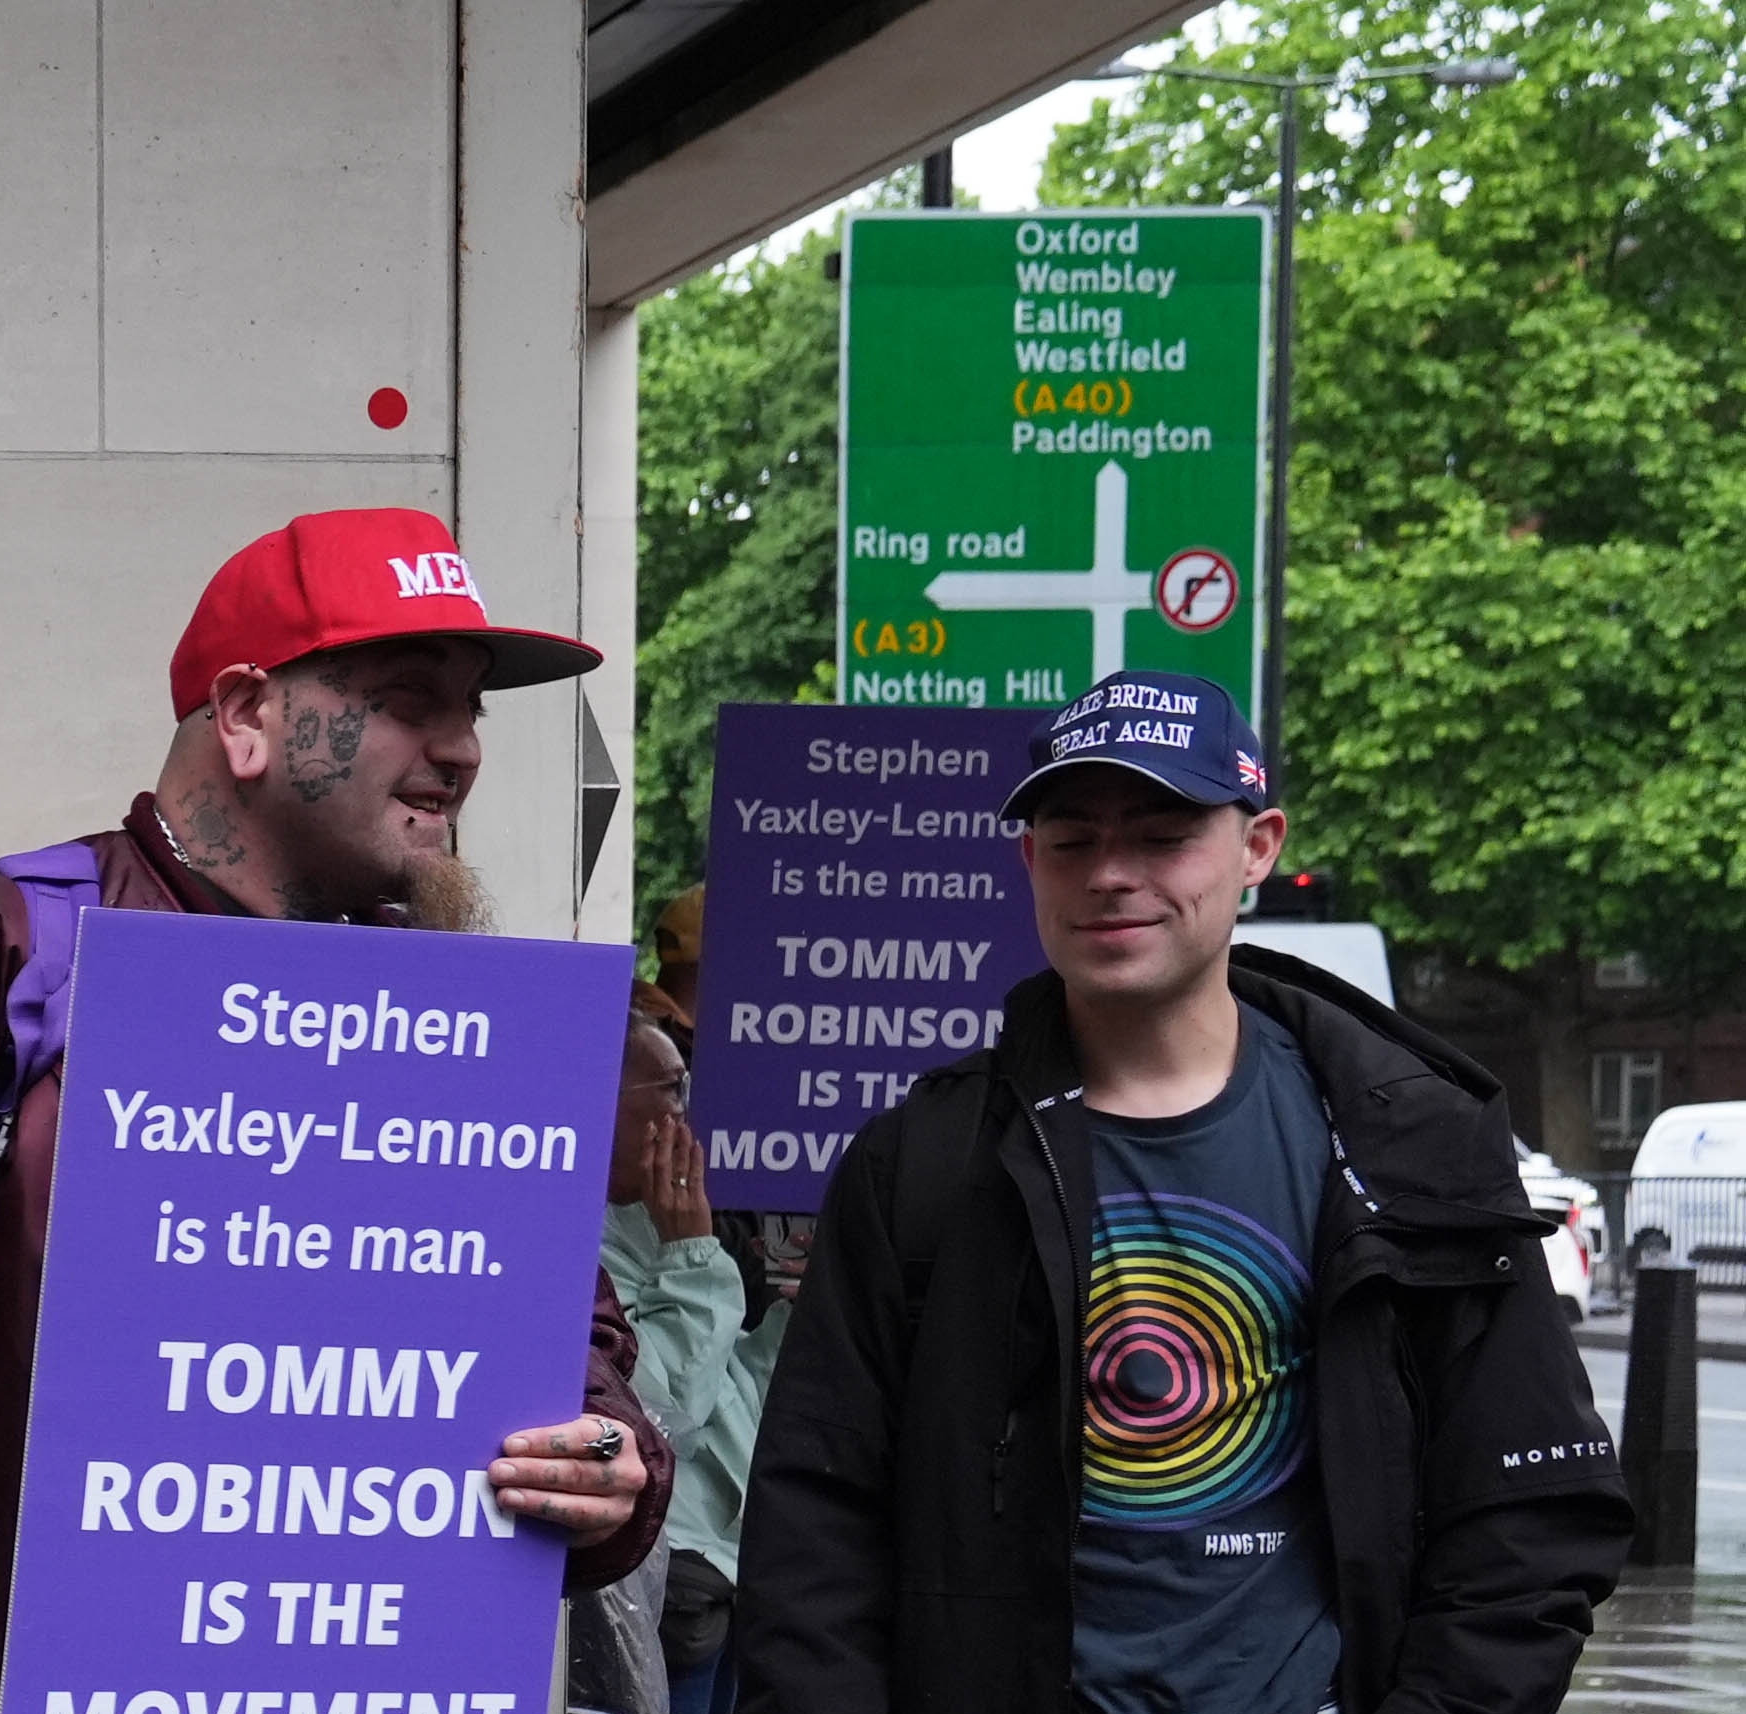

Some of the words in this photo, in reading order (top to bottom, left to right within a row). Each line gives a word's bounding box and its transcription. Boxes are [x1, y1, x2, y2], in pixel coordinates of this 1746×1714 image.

[1016, 221, 1139, 256] Oxford
[1017, 262, 1175, 298] Wembley
[1014, 299, 1122, 339] Ealing
[1015, 339, 1186, 373] Westfield
[1014, 379, 1132, 416] (A40)
[1013, 421, 1211, 458] Paddington
[855, 527, 928, 564] Ring
[948, 526, 1024, 558] road
[854, 619, 946, 656] (A3)
[854, 672, 985, 708] Notting
[1006, 670, 1065, 701] Hill
[1050, 690, 1105, 732] MAKE
[1106, 684, 1198, 714] BRITAIN
[1050, 721, 1111, 761] GREAT
[1116, 720, 1194, 748] AGAIN
[808, 740, 988, 783] Stephen
[735, 799, 1026, 845] Yaxley-Lenno
[772, 860, 803, 895] is
[817, 861, 887, 896] the
[902, 872, 1004, 899] man.
[777, 937, 991, 981] TOMMY
[218, 983, 489, 1065] Stephen
[799, 1071, 840, 1107] IS
[856, 1072, 916, 1108] TH
[104, 1089, 576, 1174] Yaxley-Lennon
[156, 1201, 206, 1264] is
[225, 1206, 331, 1268] the
[350, 1227, 501, 1275] man.
[159, 1342, 479, 1418] TOMMY
[1503, 1442, 1608, 1467] MONTEC
[1206, 1534, 1253, 1555] HANG
[182, 1581, 248, 1644] IS
[269, 1583, 404, 1645] THE
